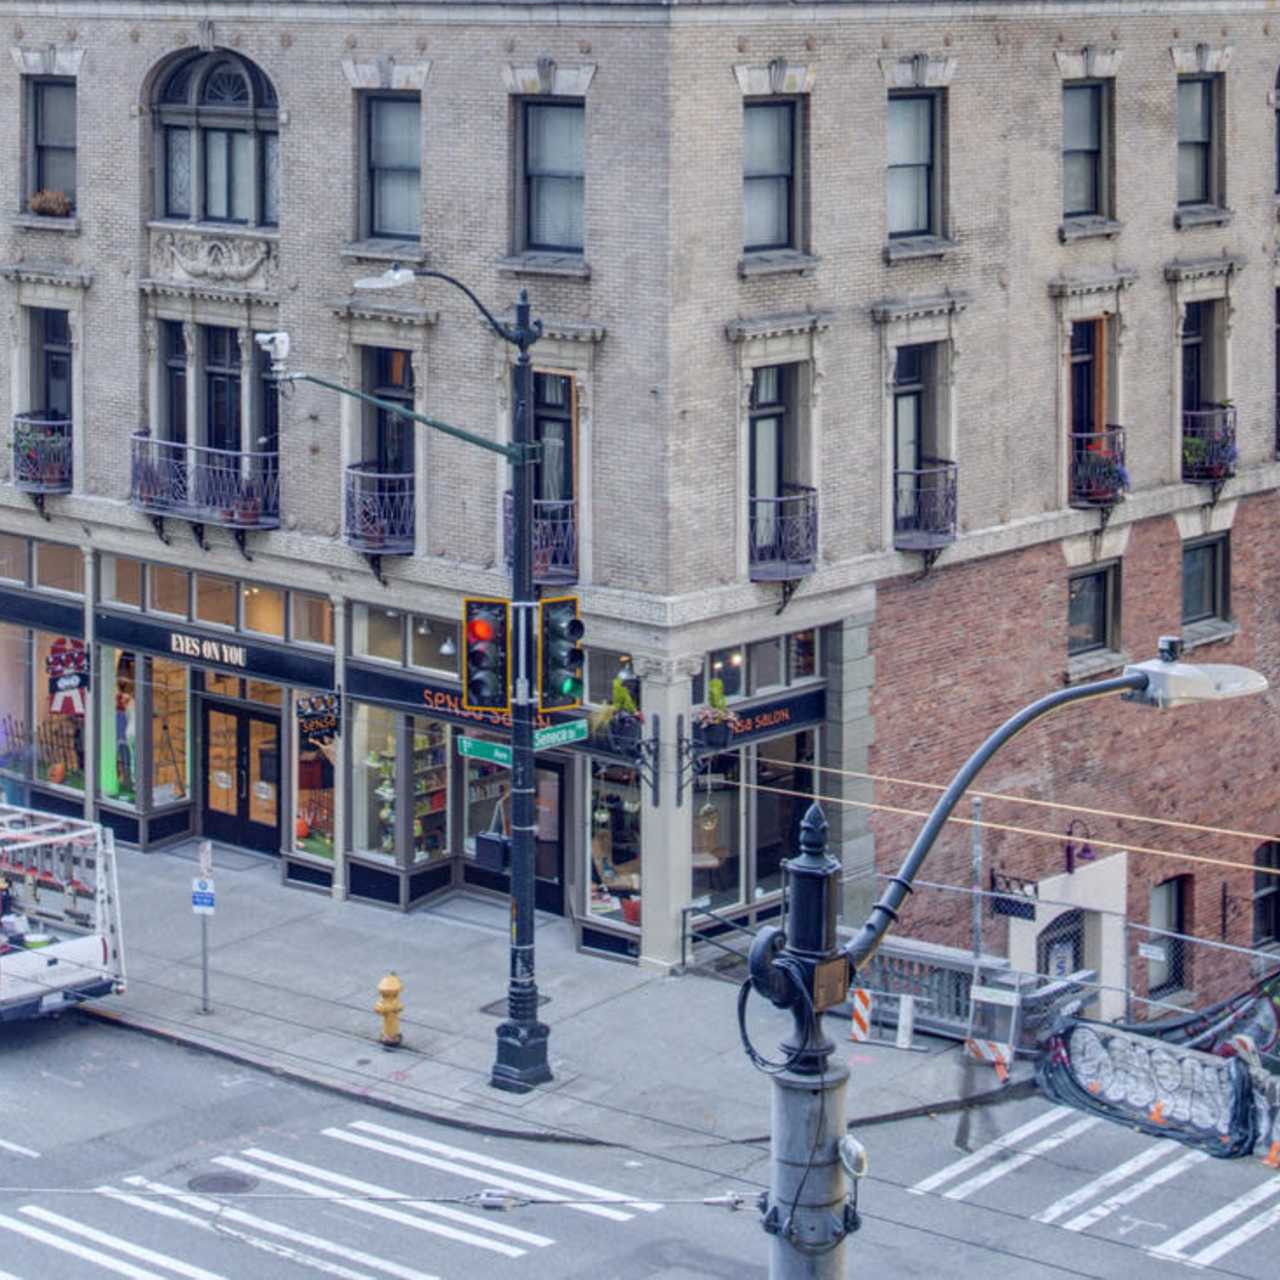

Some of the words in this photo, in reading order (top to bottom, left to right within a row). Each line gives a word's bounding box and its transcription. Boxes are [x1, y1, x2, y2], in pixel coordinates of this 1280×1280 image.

[171, 632, 201, 657] EYES
[201, 639, 221, 662] ON
[221, 643, 247, 668] YOU
